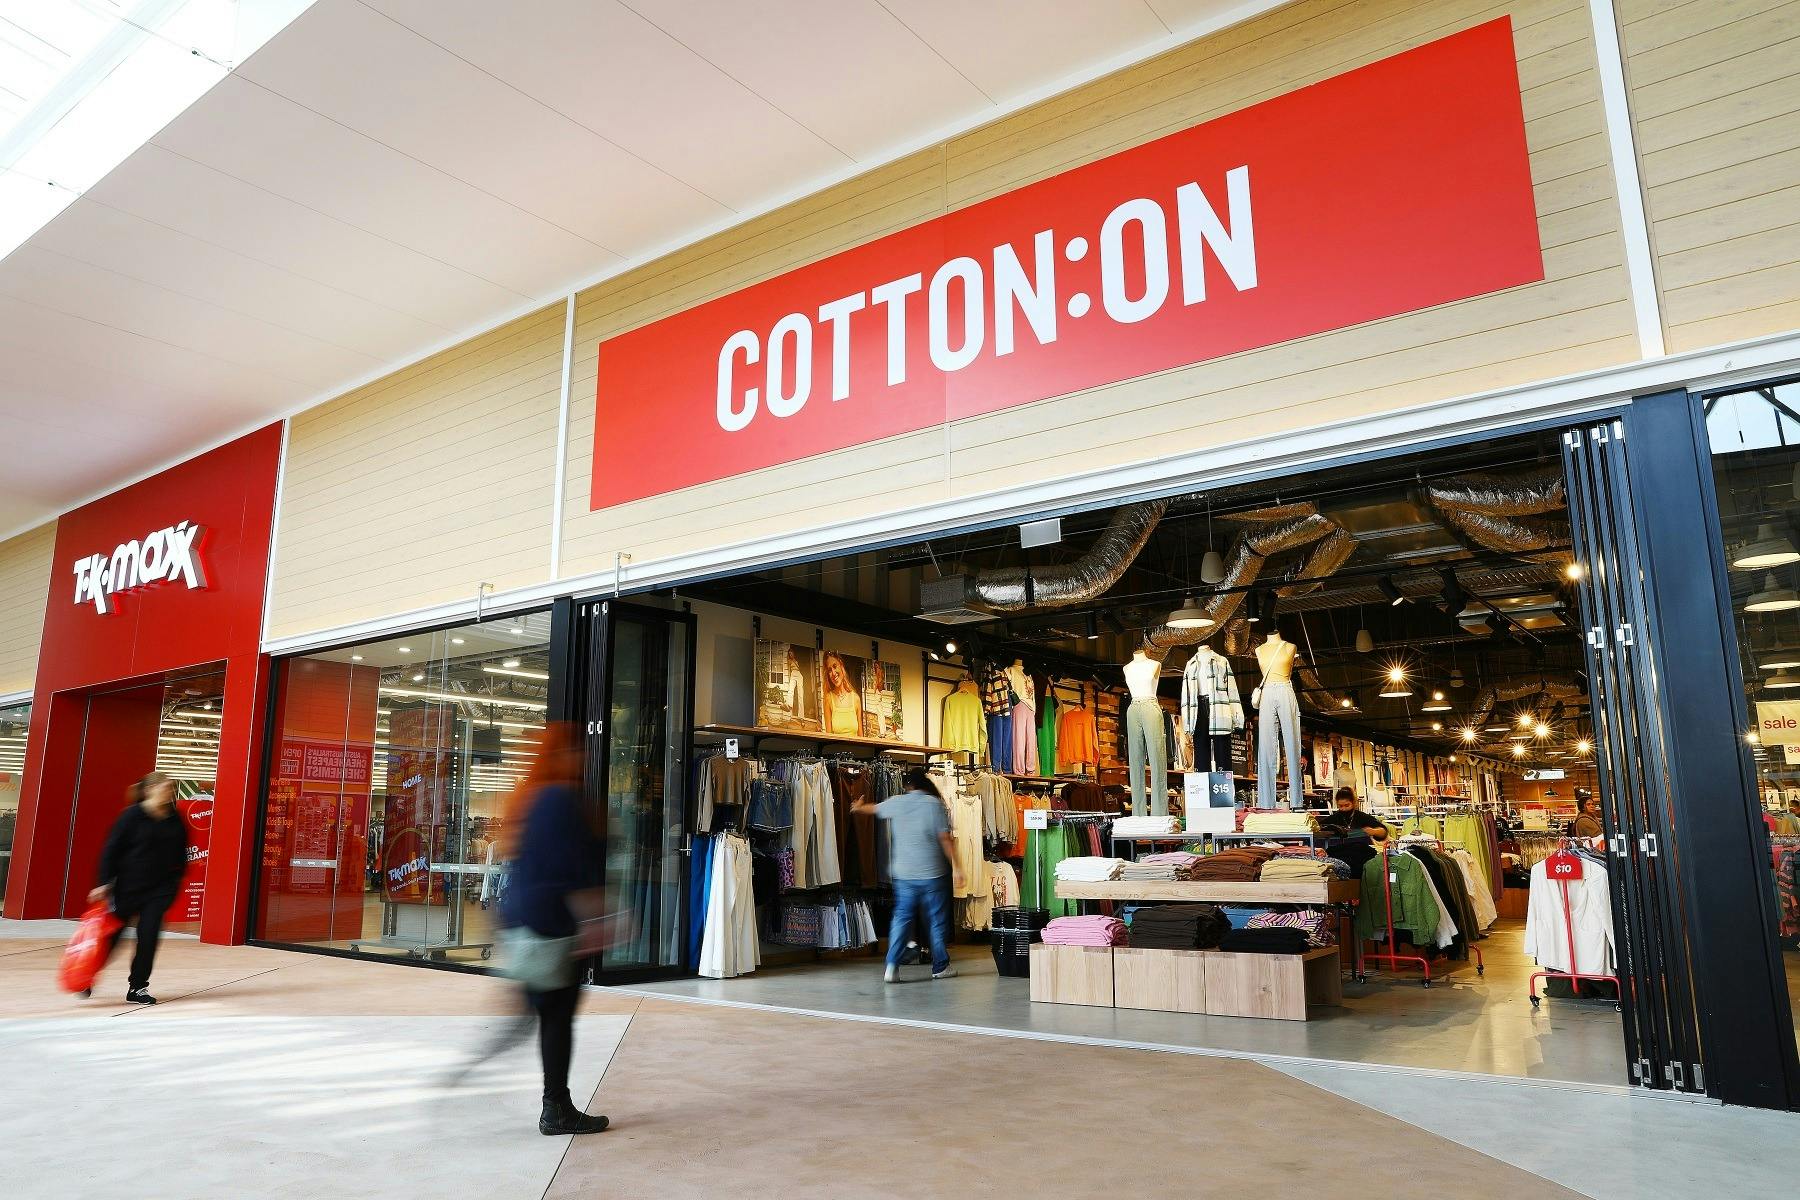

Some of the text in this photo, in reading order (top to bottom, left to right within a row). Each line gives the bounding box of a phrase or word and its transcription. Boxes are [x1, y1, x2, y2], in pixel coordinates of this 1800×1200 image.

[715, 164, 1258, 432] COTTON:ON
[1764, 715, 1797, 729] sale
[402, 773, 422, 790] HOME
[1212, 783, 1229, 795] $15
[1554, 863, 1572, 874] $10
